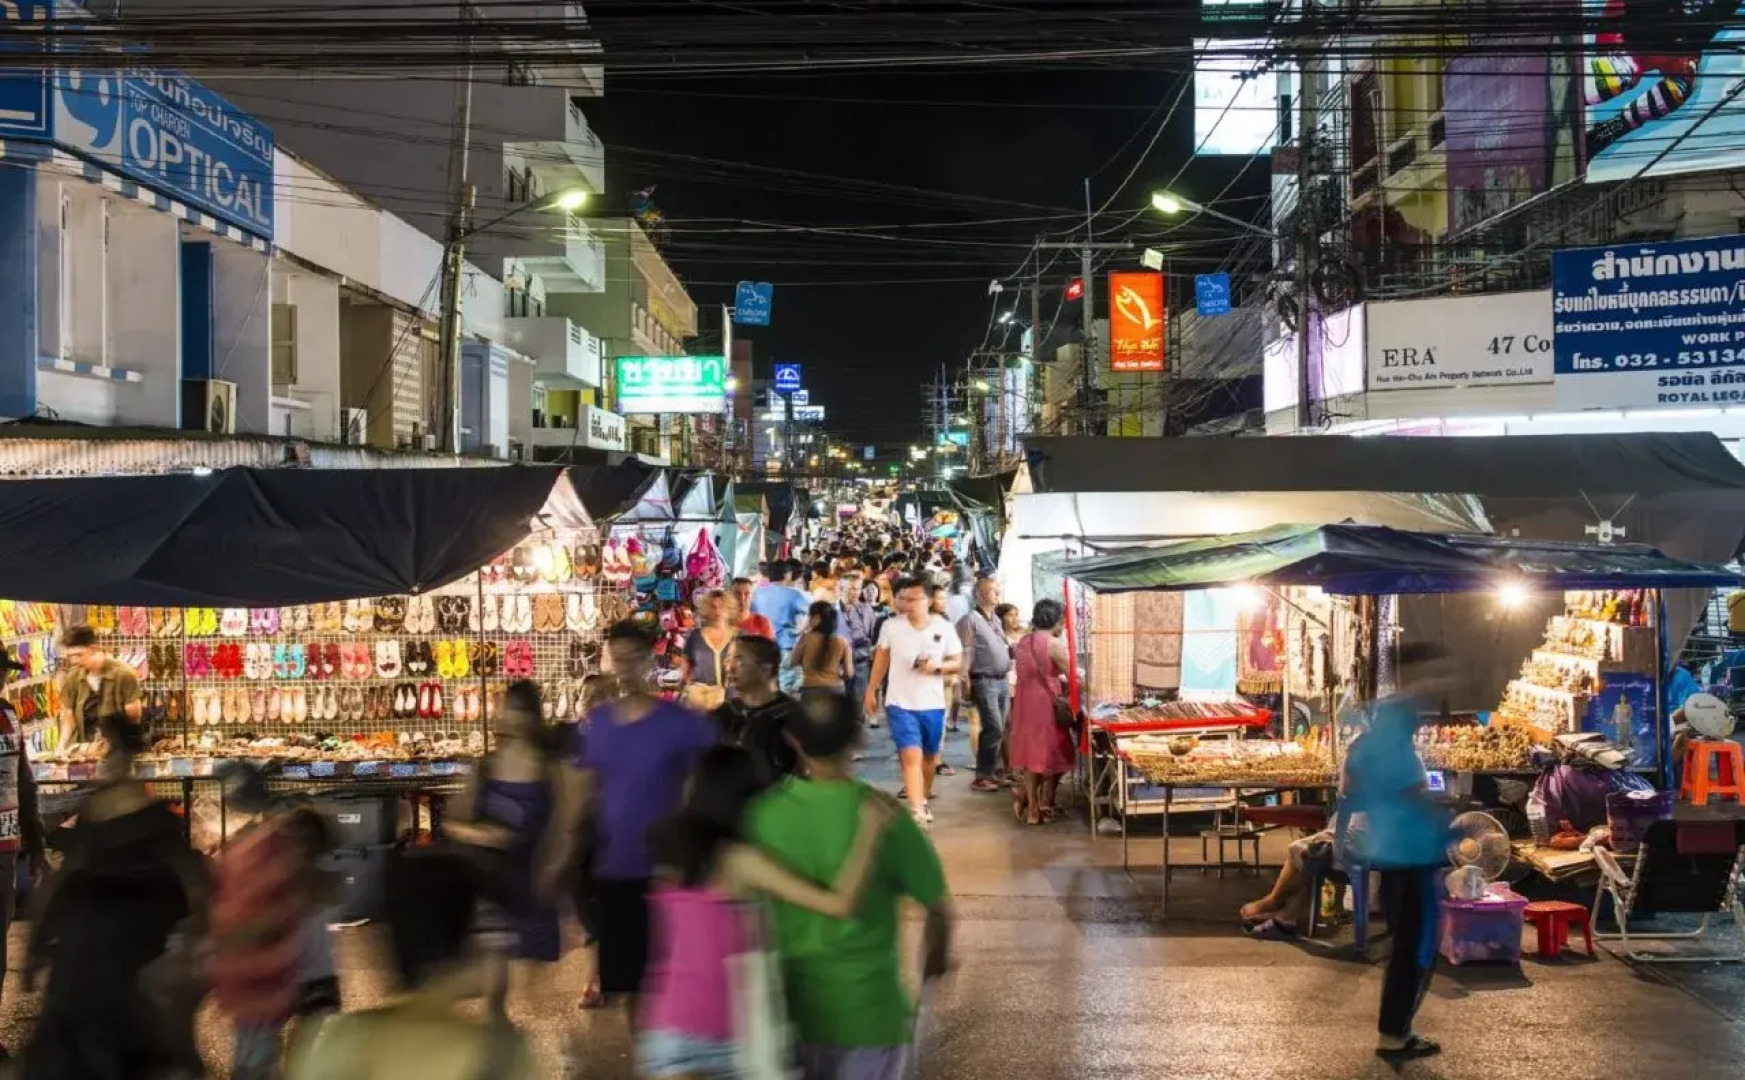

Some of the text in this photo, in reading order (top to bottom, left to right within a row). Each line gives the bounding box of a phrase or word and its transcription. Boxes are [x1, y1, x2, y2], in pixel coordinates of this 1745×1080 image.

[130, 89, 147, 113] TOP
[129, 117, 270, 226] OPTICAL
[1592, 249, 1745, 281] สำนักงาน
[1487, 334, 1554, 355] 47 Co
[1682, 332, 1731, 345] WORK
[1382, 347, 1436, 367] ERA
[1572, 352, 1609, 370] โทร.
[1614, 353, 1658, 367] 032
[1439, 370, 1469, 381] Property
[1472, 370, 1502, 379] Network
[1657, 371, 1705, 387] รอยัล
[1657, 390, 1709, 403] ROYAL
